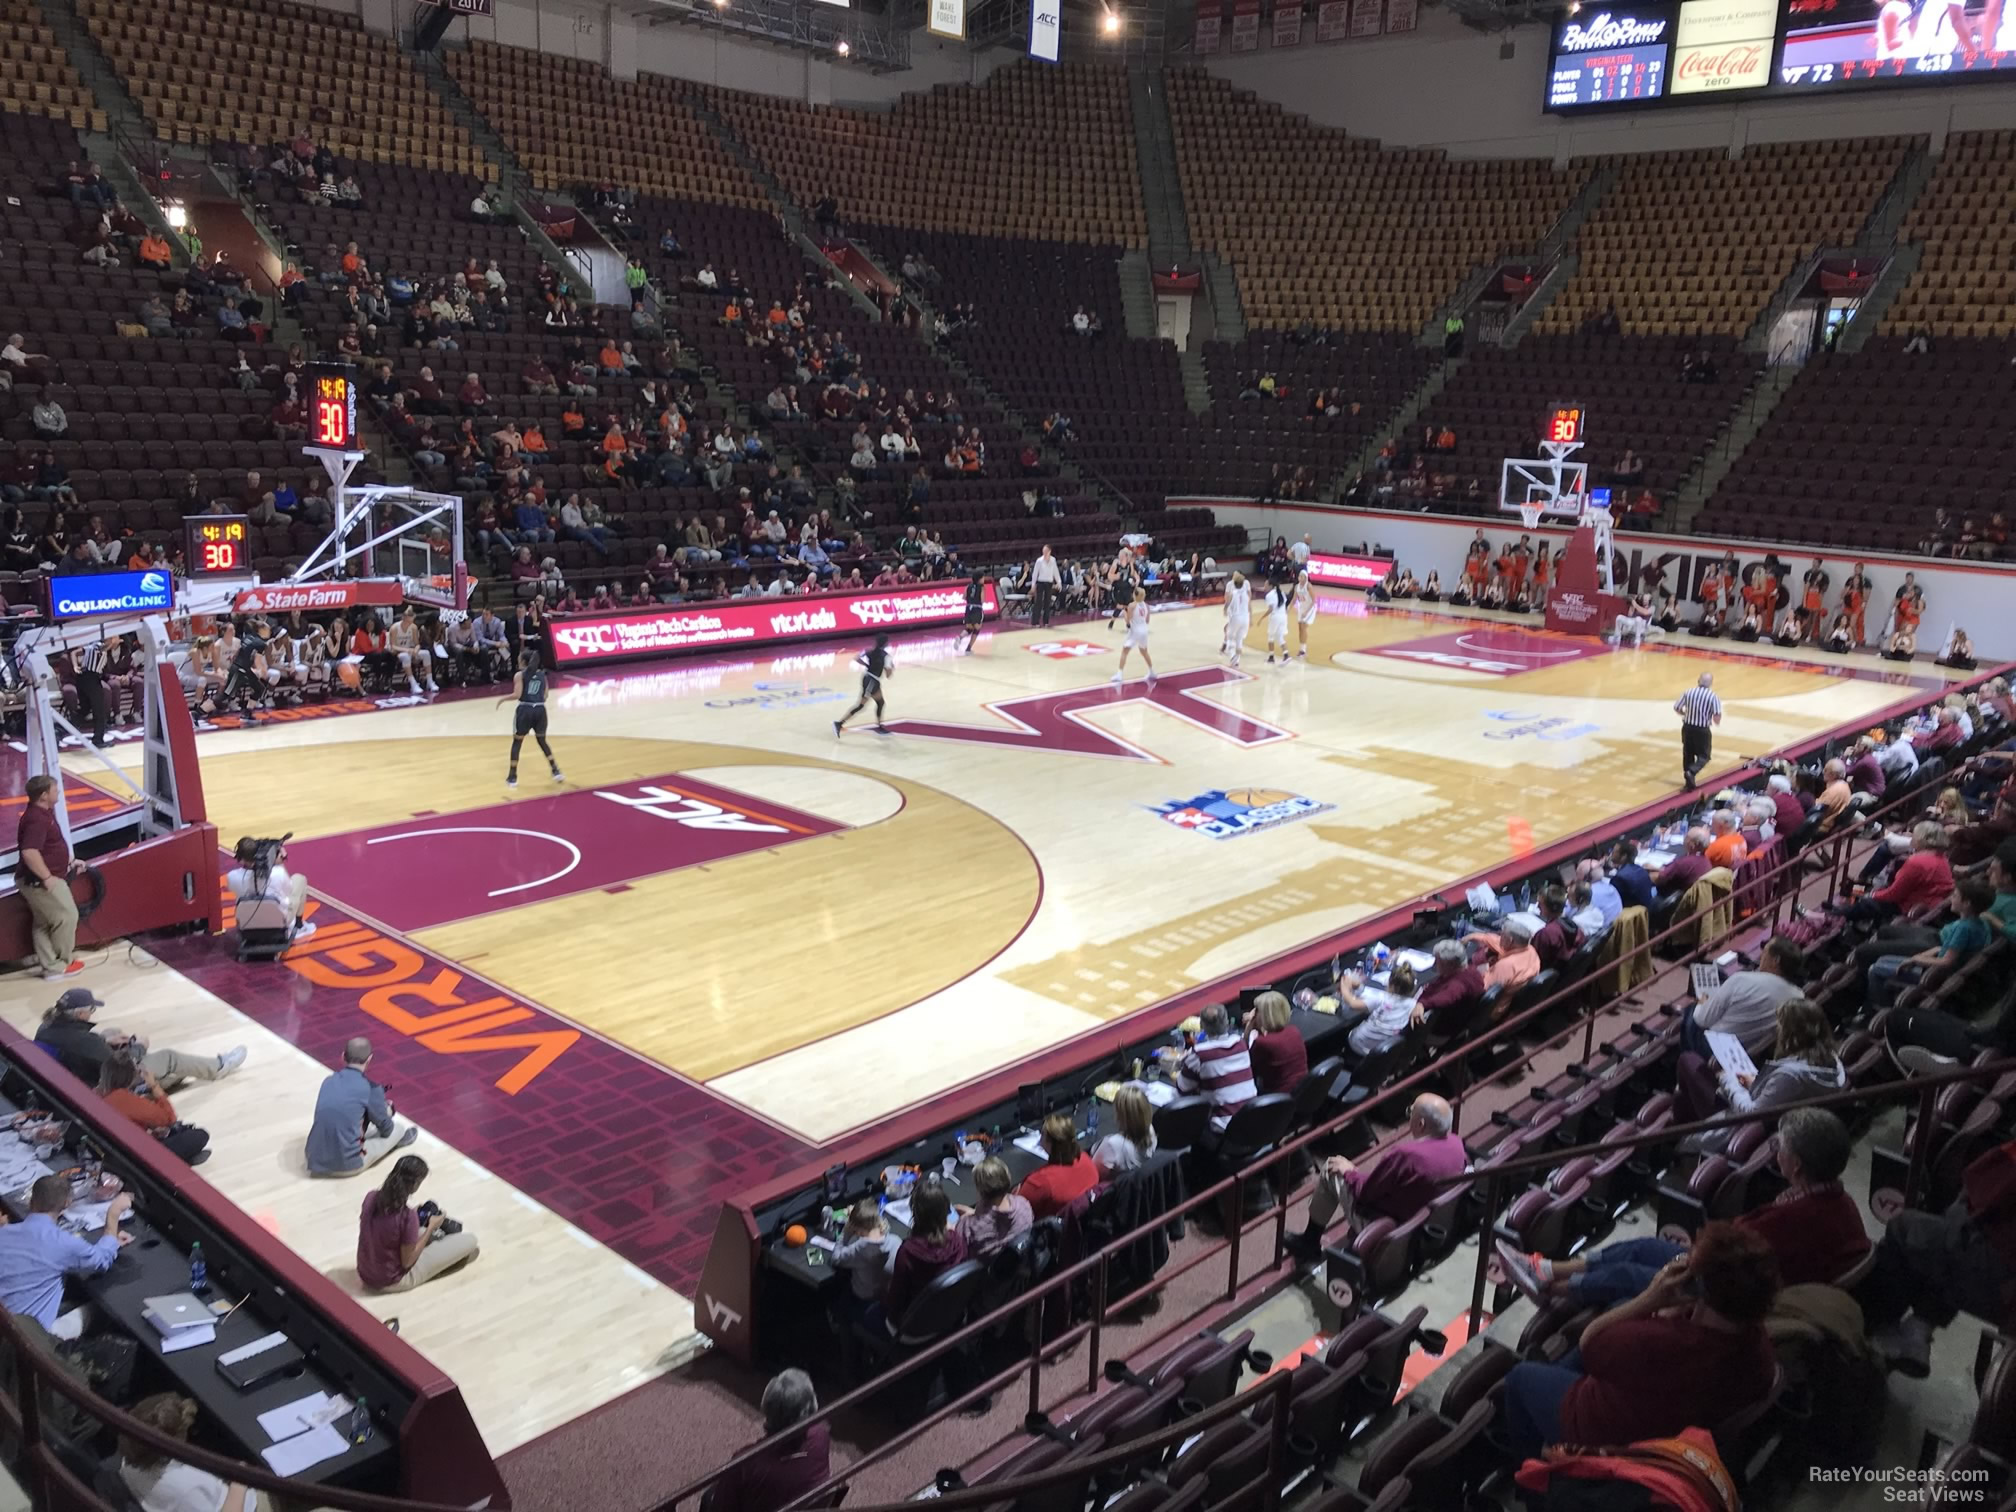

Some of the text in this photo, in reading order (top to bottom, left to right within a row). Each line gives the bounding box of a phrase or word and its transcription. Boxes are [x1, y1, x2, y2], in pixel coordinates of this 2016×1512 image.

[936, 12, 957, 24] FOREST
[1036, 12, 1058, 25] ACC
[1586, 54, 1634, 68] VIRGINIA TECH
[1678, 46, 1766, 80] Coca-Cola
[1915, 54, 1952, 72] 4:19
[1554, 69, 1581, 81] PLAYER
[1704, 77, 1731, 87] zero
[1782, 64, 1834, 83] VT 72
[1553, 82, 1576, 93] FOULS
[1551, 93, 1577, 105] POINTS
[321, 377, 345, 400] 4:19
[320, 402, 344, 443] 30
[1554, 420, 1576, 441] 30
[203, 523, 243, 541] 4:19
[205, 544, 234, 569] 30
[616, 623, 657, 640] Virginia
[656, 616, 682, 633] Tech
[682, 614, 722, 631] Carilion
[770, 608, 836, 635] vtc.vt.edu
[621, 637, 647, 651] School
[655, 633, 687, 646] Medicine
[695, 629, 727, 643] Research
[727, 627, 755, 638] Institute
[528, 681, 541, 694] 10
[593, 786, 790, 834] ACC
[1194, 797, 1322, 840] CLASSIC
[704, 1292, 743, 1333] VT
